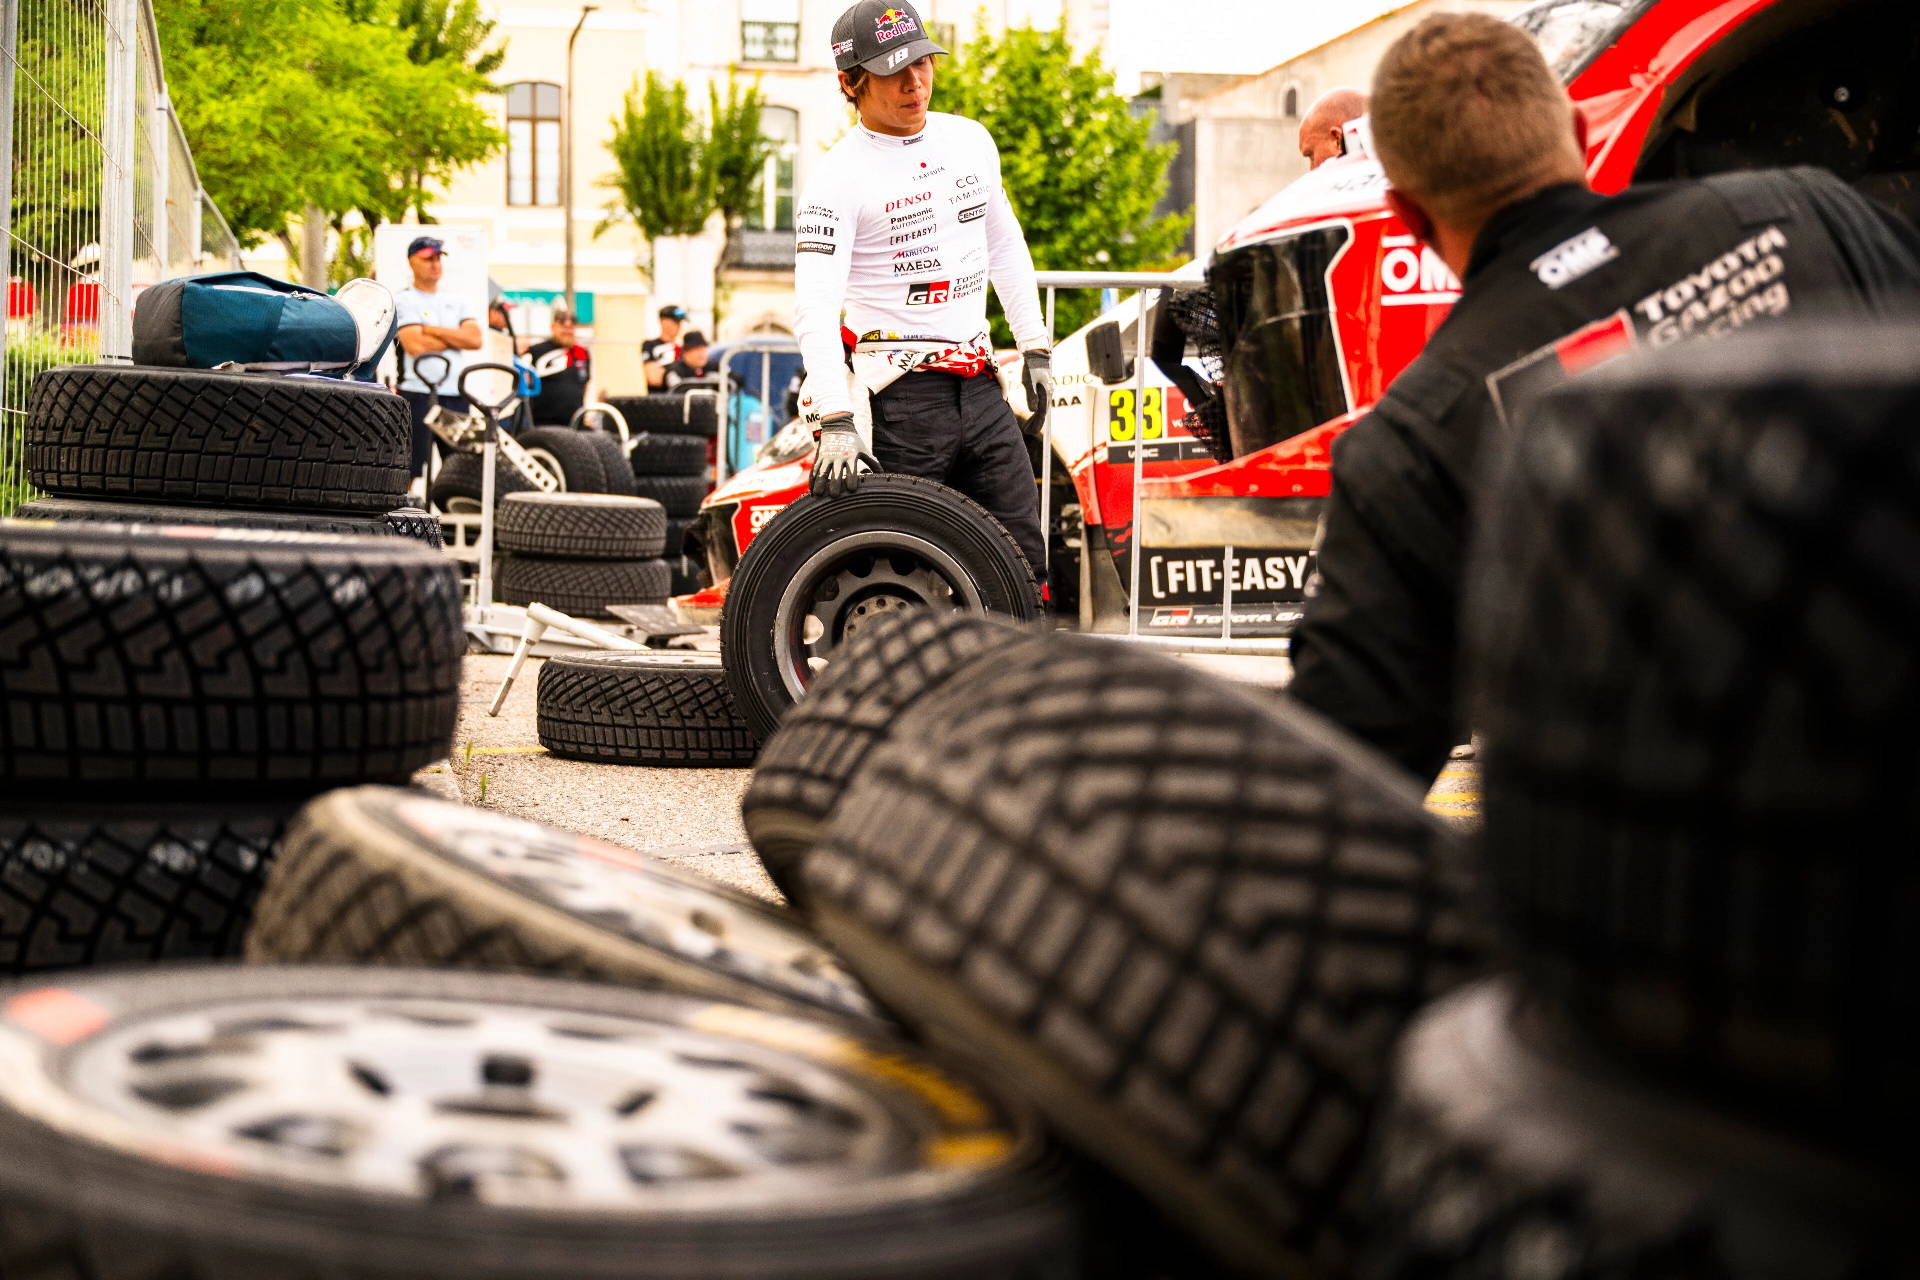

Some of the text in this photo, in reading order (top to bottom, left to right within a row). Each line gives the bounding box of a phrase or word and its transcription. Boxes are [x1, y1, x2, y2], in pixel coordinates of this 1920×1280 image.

[876, 18, 918, 43] Red Bull
[887, 47, 909, 69] 18
[885, 191, 932, 213] DENSO
[890, 207, 933, 225] Panasonic
[890, 214, 935, 231] AUTOMOTIVE
[893, 258, 942, 273] MAEDA
[1380, 246, 1463, 293] OM
[1635, 225, 1787, 322] TOYOTA
[906, 289, 949, 305] GR
[952, 285, 982, 300] Racing
[1109, 388, 1163, 442] 33
